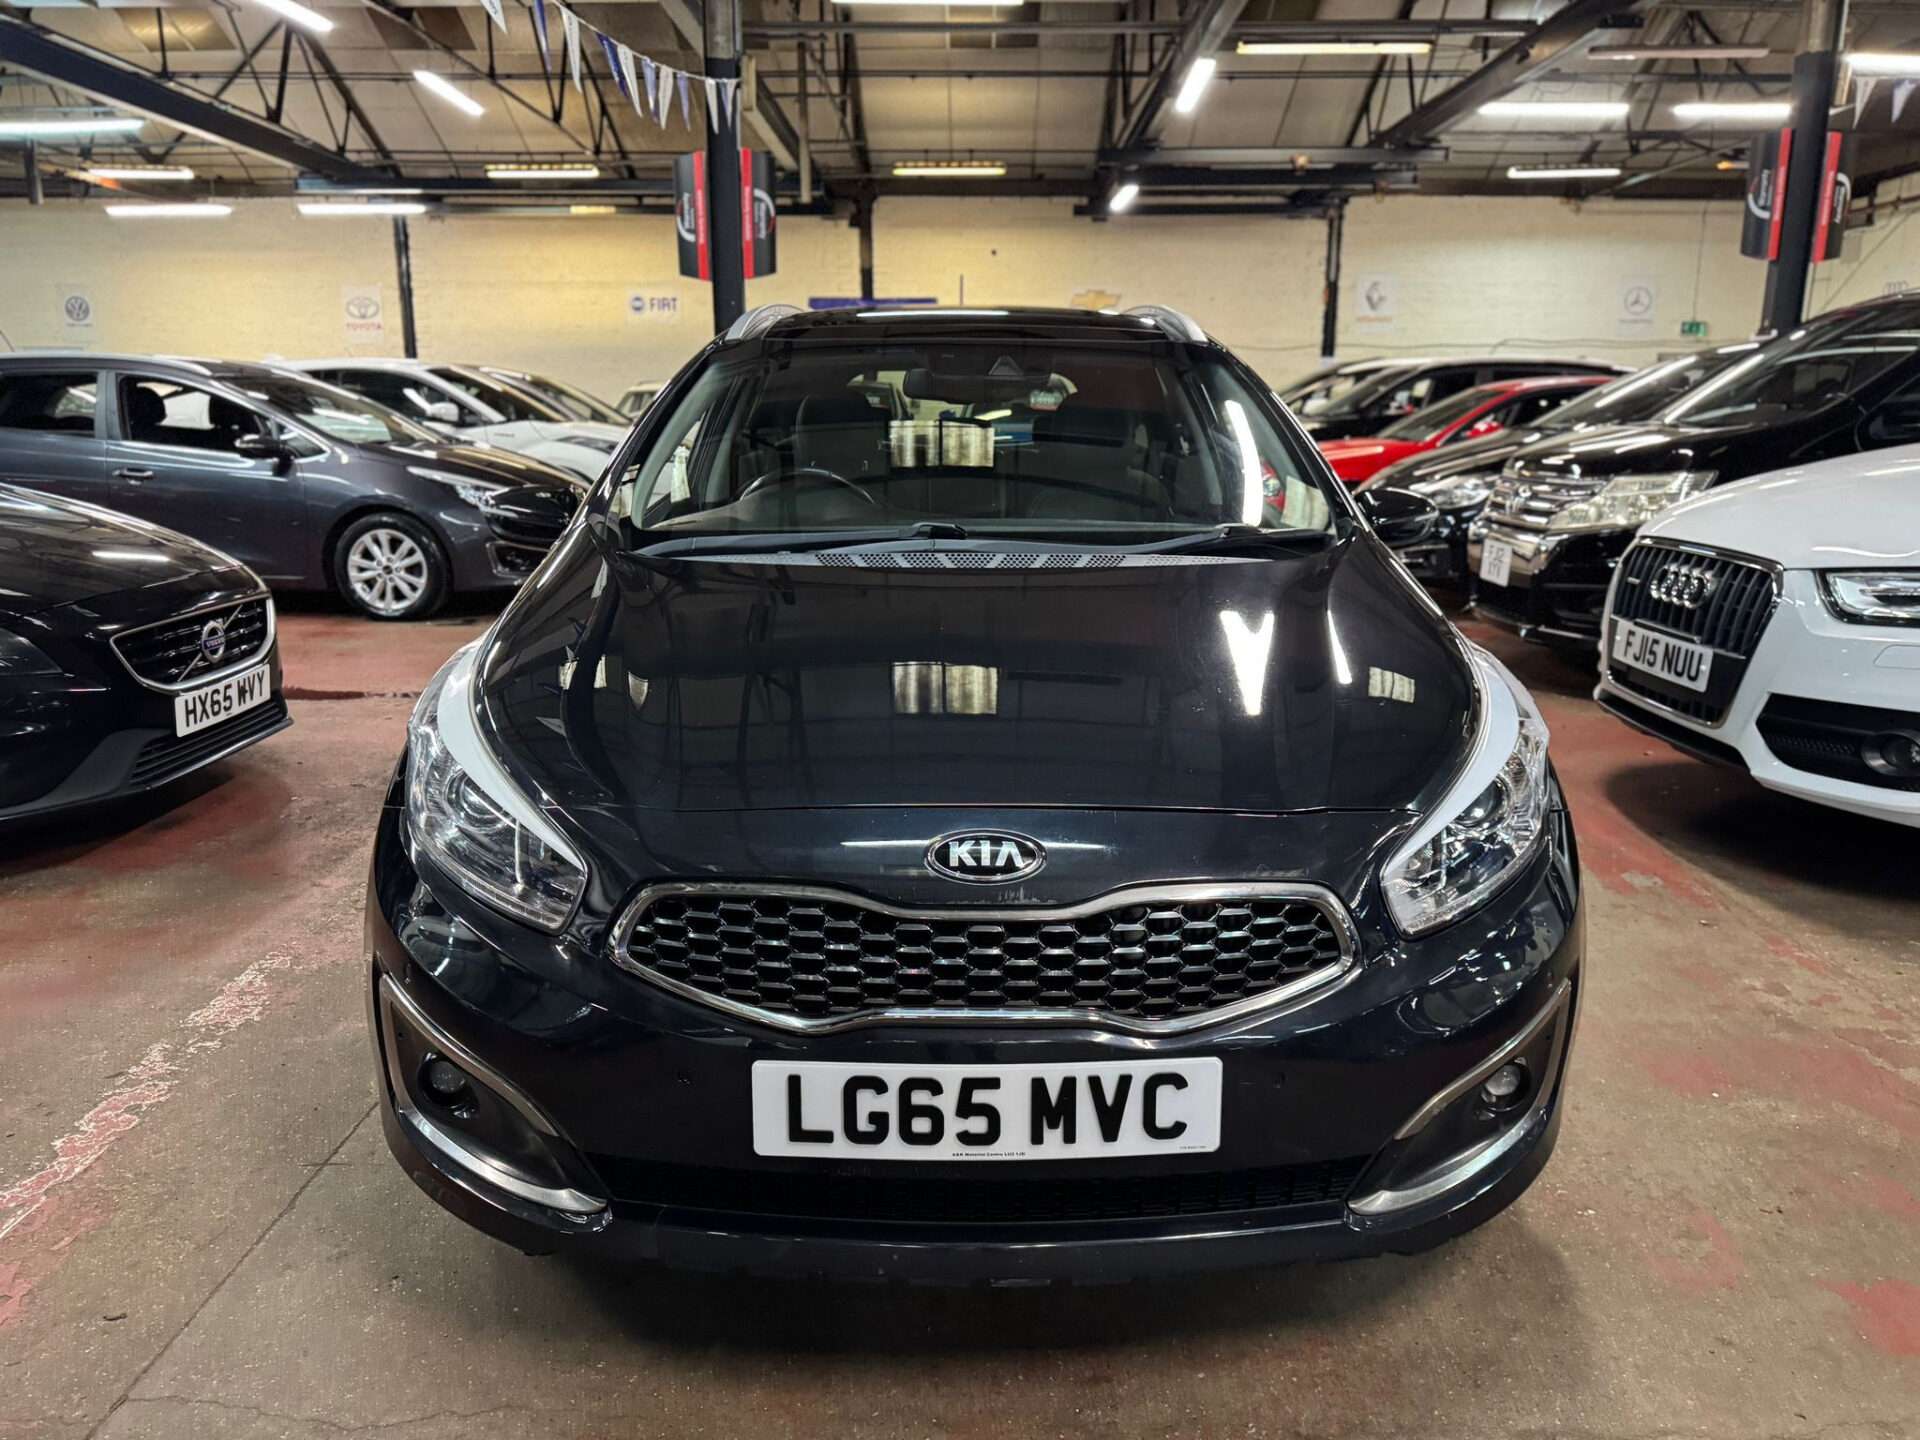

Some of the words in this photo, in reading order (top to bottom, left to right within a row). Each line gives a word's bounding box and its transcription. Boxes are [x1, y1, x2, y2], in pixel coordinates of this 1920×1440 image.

[649, 297, 677, 312] FIAT
[1624, 629, 1659, 668] FJ15
[1661, 642, 1703, 682] NUU
[184, 684, 232, 727] HX65
[948, 840, 1024, 868] KIA
[788, 1074, 1001, 1146] LG65
[1030, 1072, 1188, 1145] MVC
